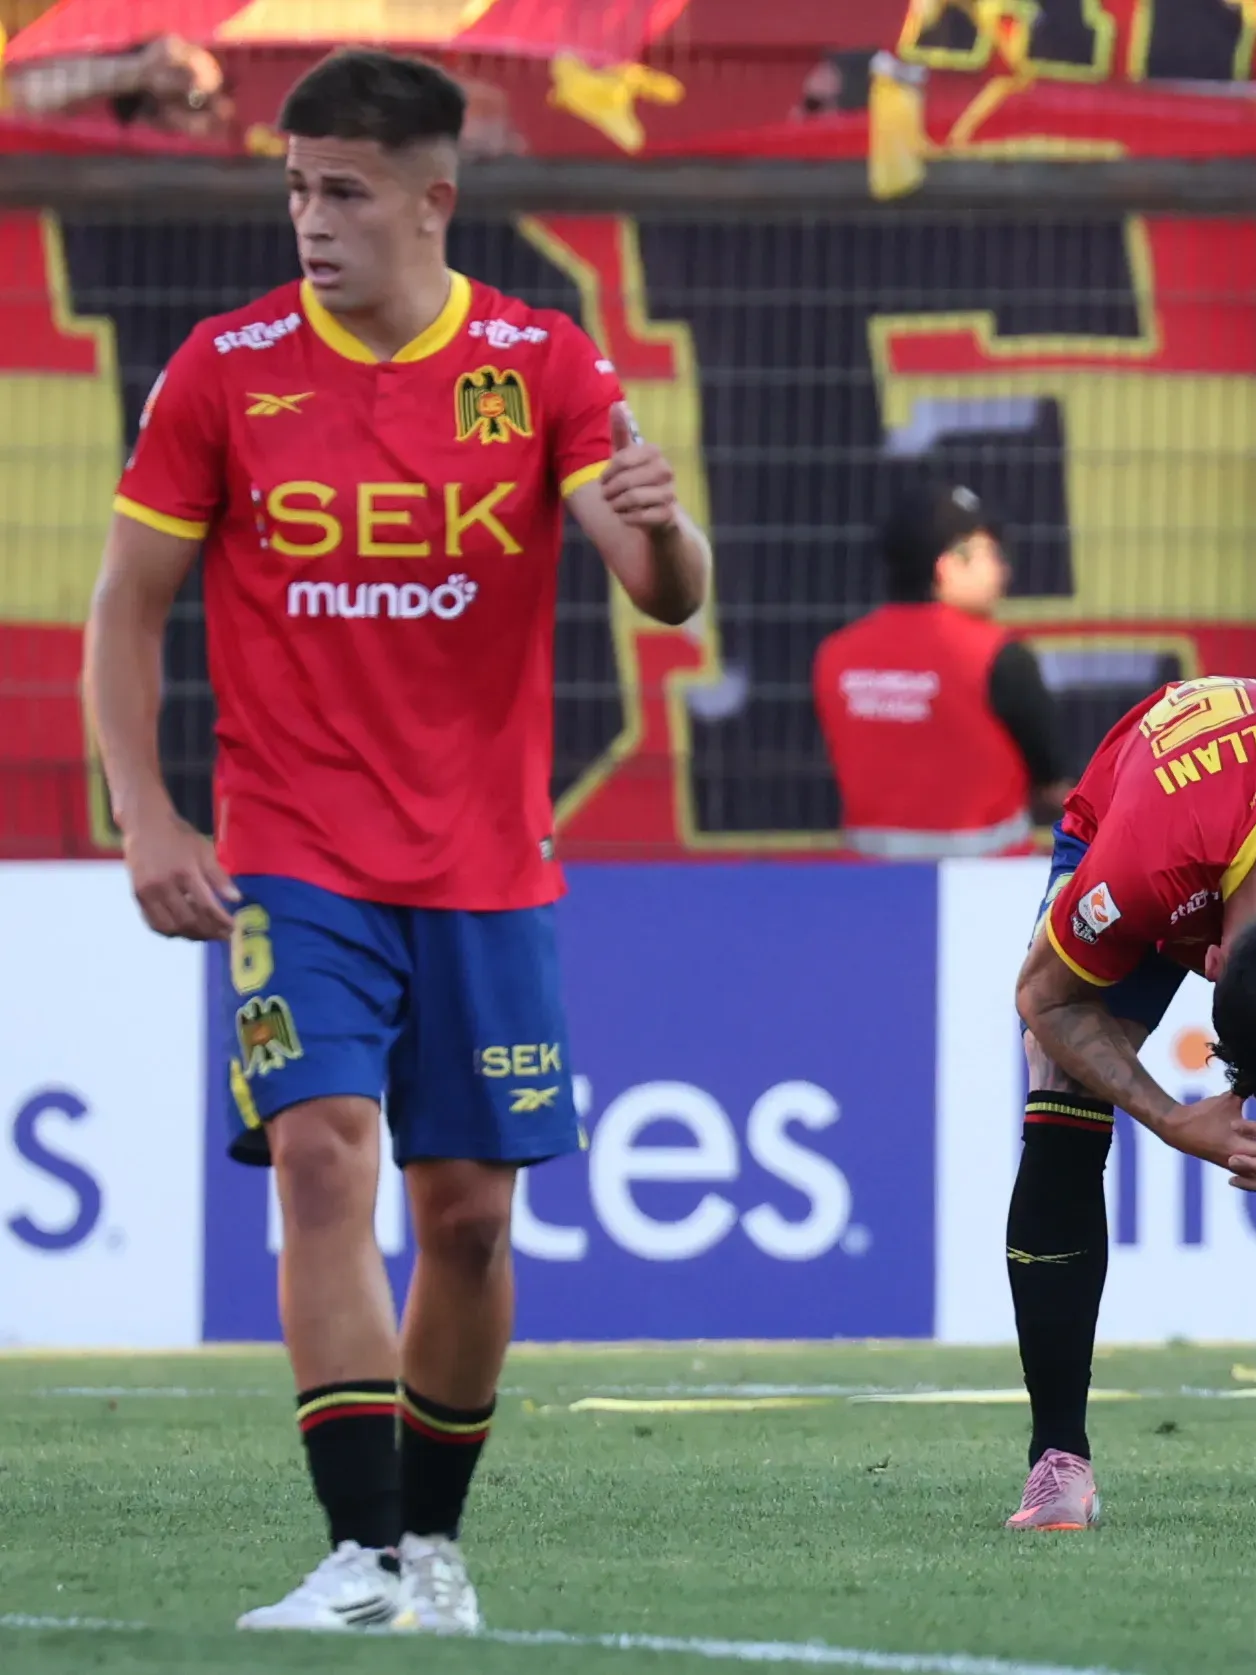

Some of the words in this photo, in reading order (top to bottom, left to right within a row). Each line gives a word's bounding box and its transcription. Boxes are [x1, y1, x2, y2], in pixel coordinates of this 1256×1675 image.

[266, 479, 525, 558] SEK
[229, 902, 275, 997] 6
[480, 1041, 562, 1079] SEK
